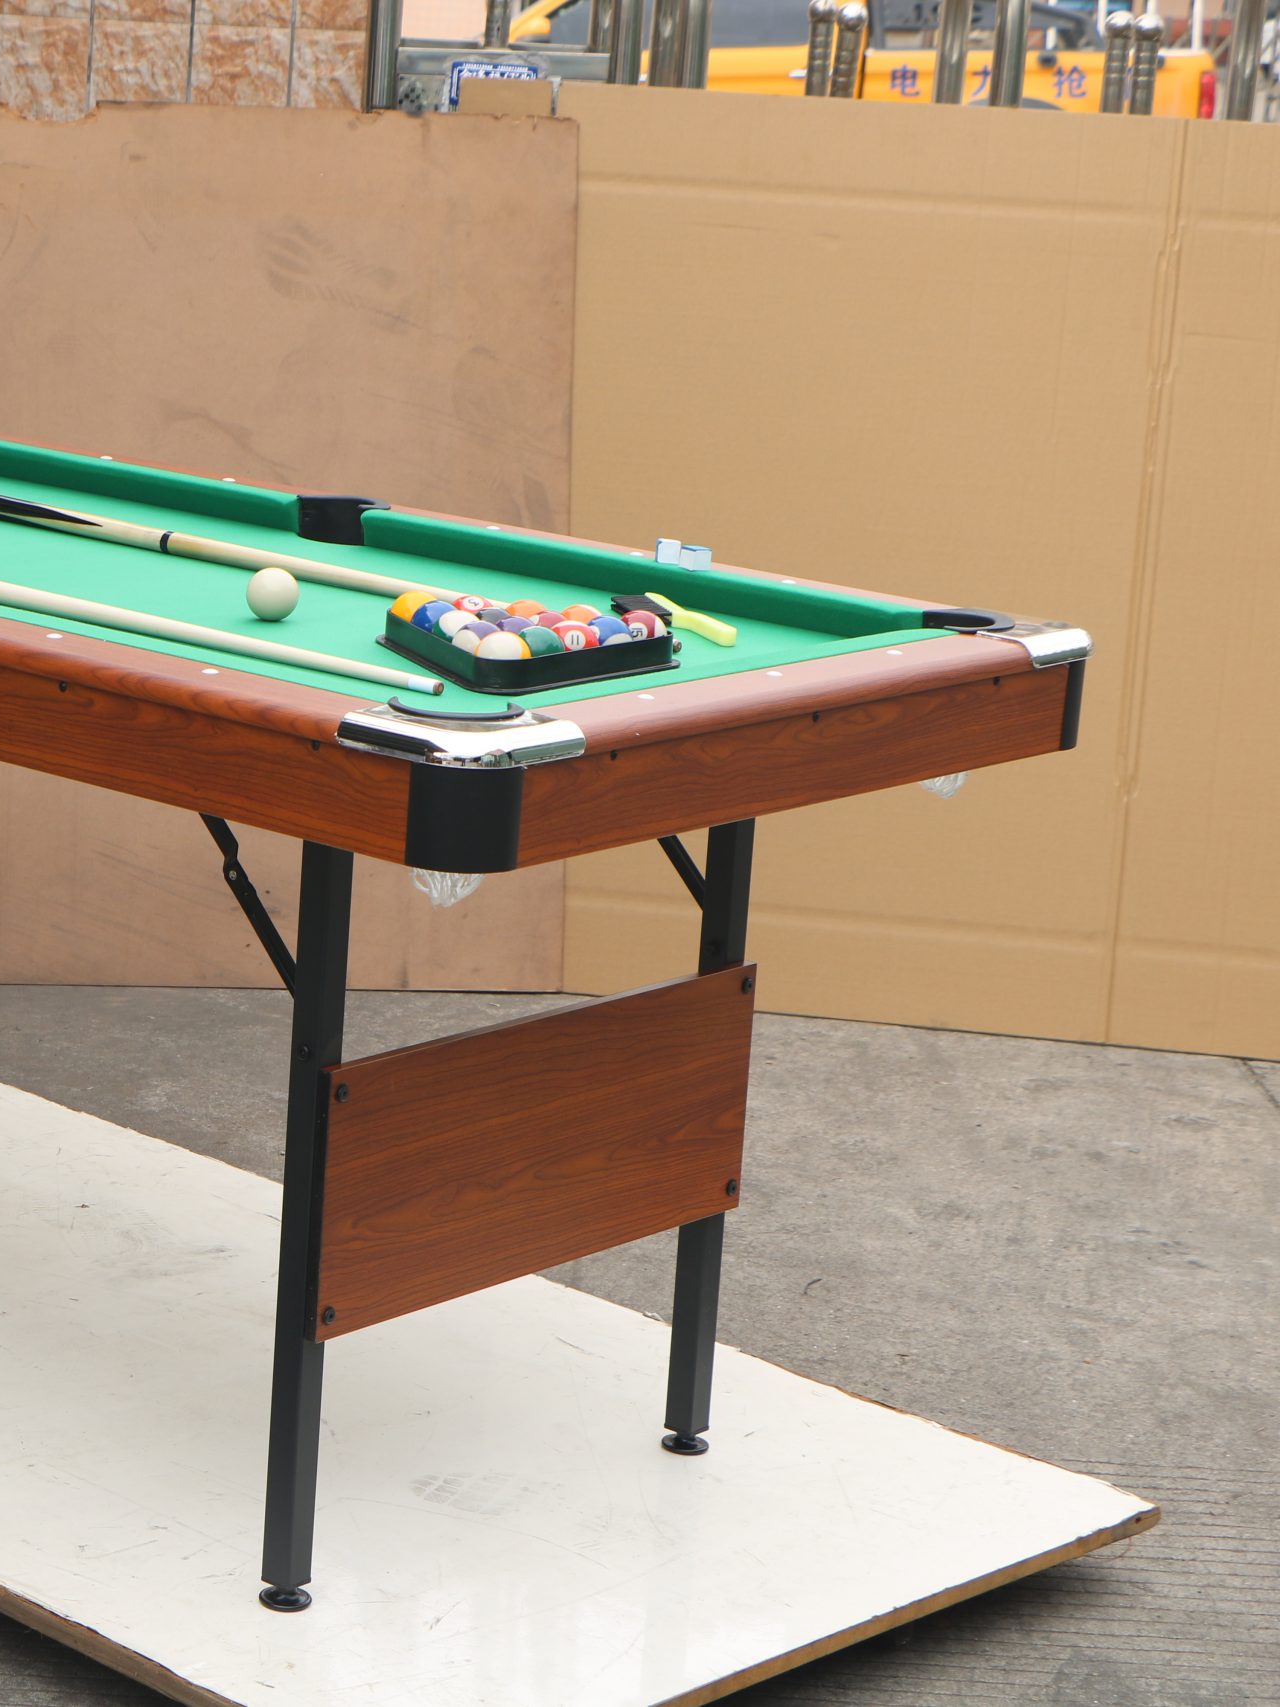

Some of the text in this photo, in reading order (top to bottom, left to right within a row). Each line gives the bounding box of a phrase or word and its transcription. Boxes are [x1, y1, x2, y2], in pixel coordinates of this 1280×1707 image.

[467, 598, 480, 607] 3
[631, 627, 644, 638] 15
[571, 633, 580, 646] 11
